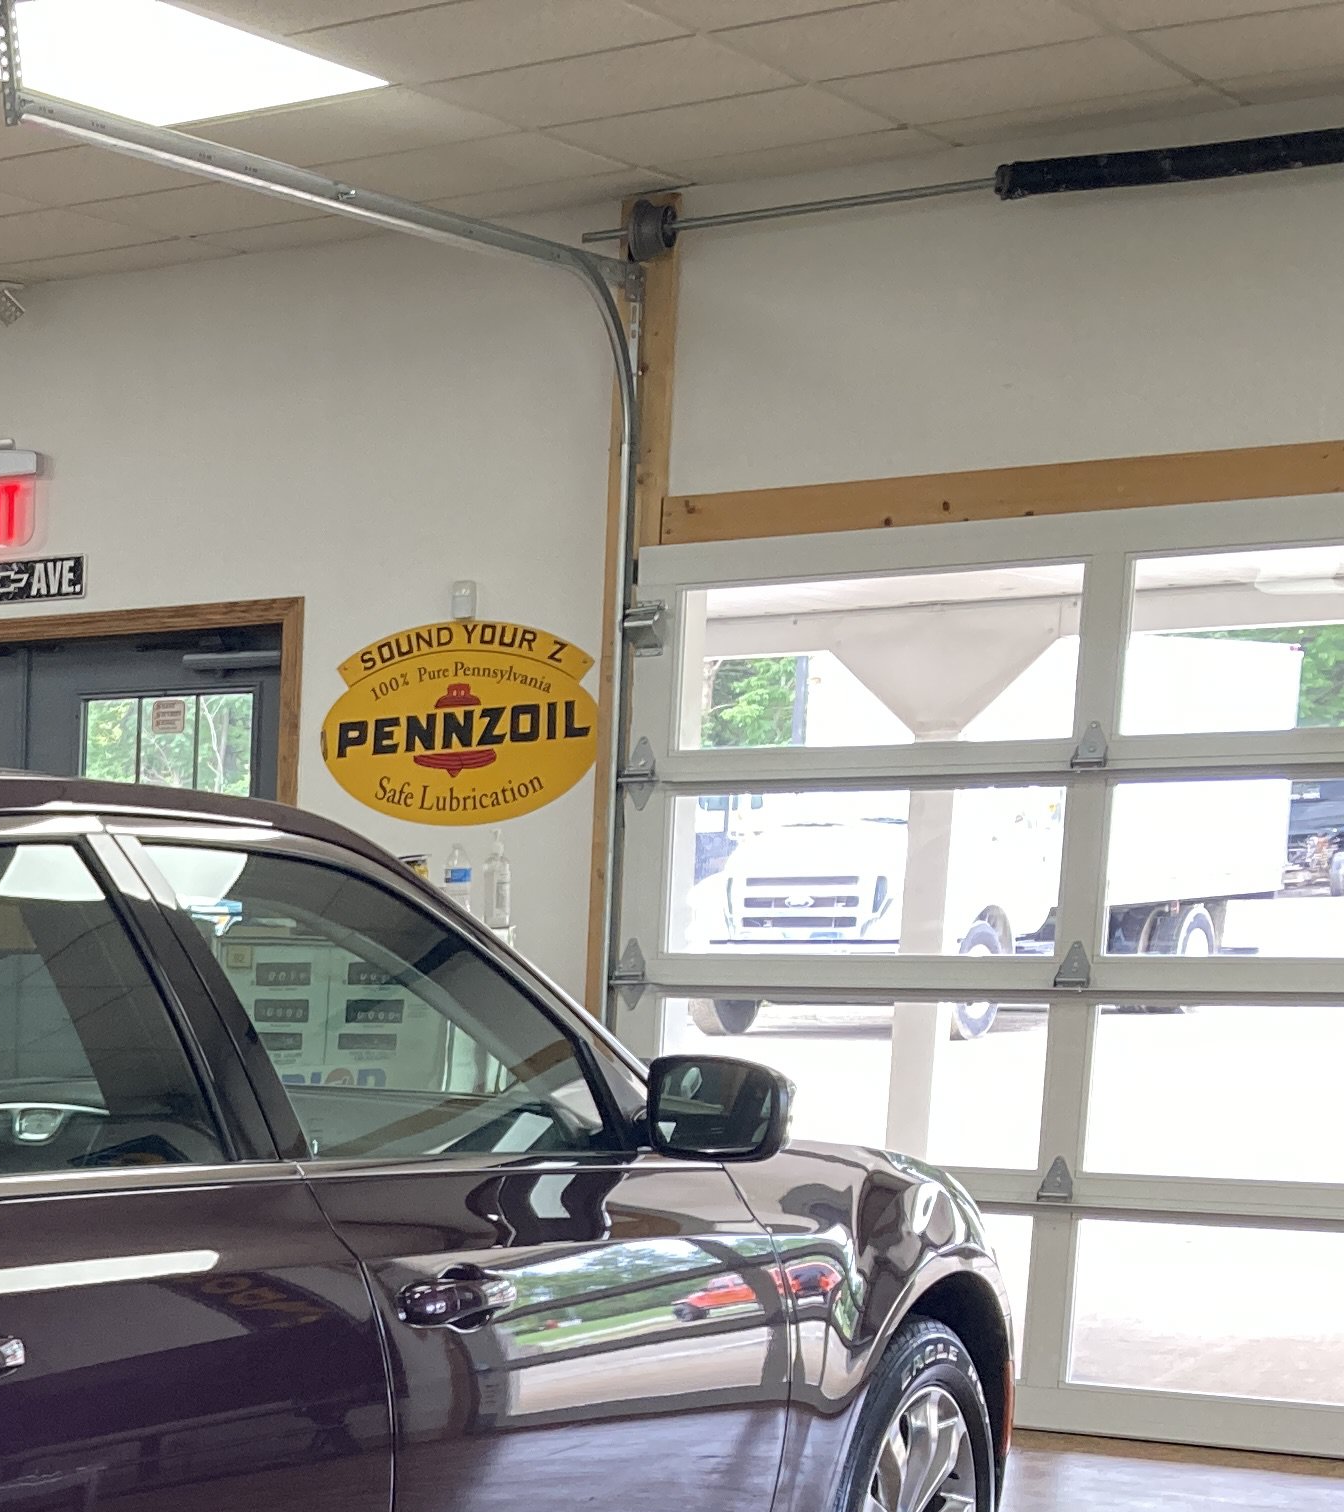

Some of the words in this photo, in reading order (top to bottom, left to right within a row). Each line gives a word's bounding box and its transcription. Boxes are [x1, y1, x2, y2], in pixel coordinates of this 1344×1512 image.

[30, 560, 81, 596] AVE.
[359, 627, 454, 671] SOUND
[462, 624, 537, 651] YOUR
[547, 640, 568, 662] Z
[370, 672, 410, 701] 100%
[418, 666, 450, 682] Pure
[454, 661, 552, 693] Pennsylvania
[336, 700, 591, 758] PENNZOIL
[375, 775, 414, 807] Safe
[419, 775, 545, 812] Lubrication
